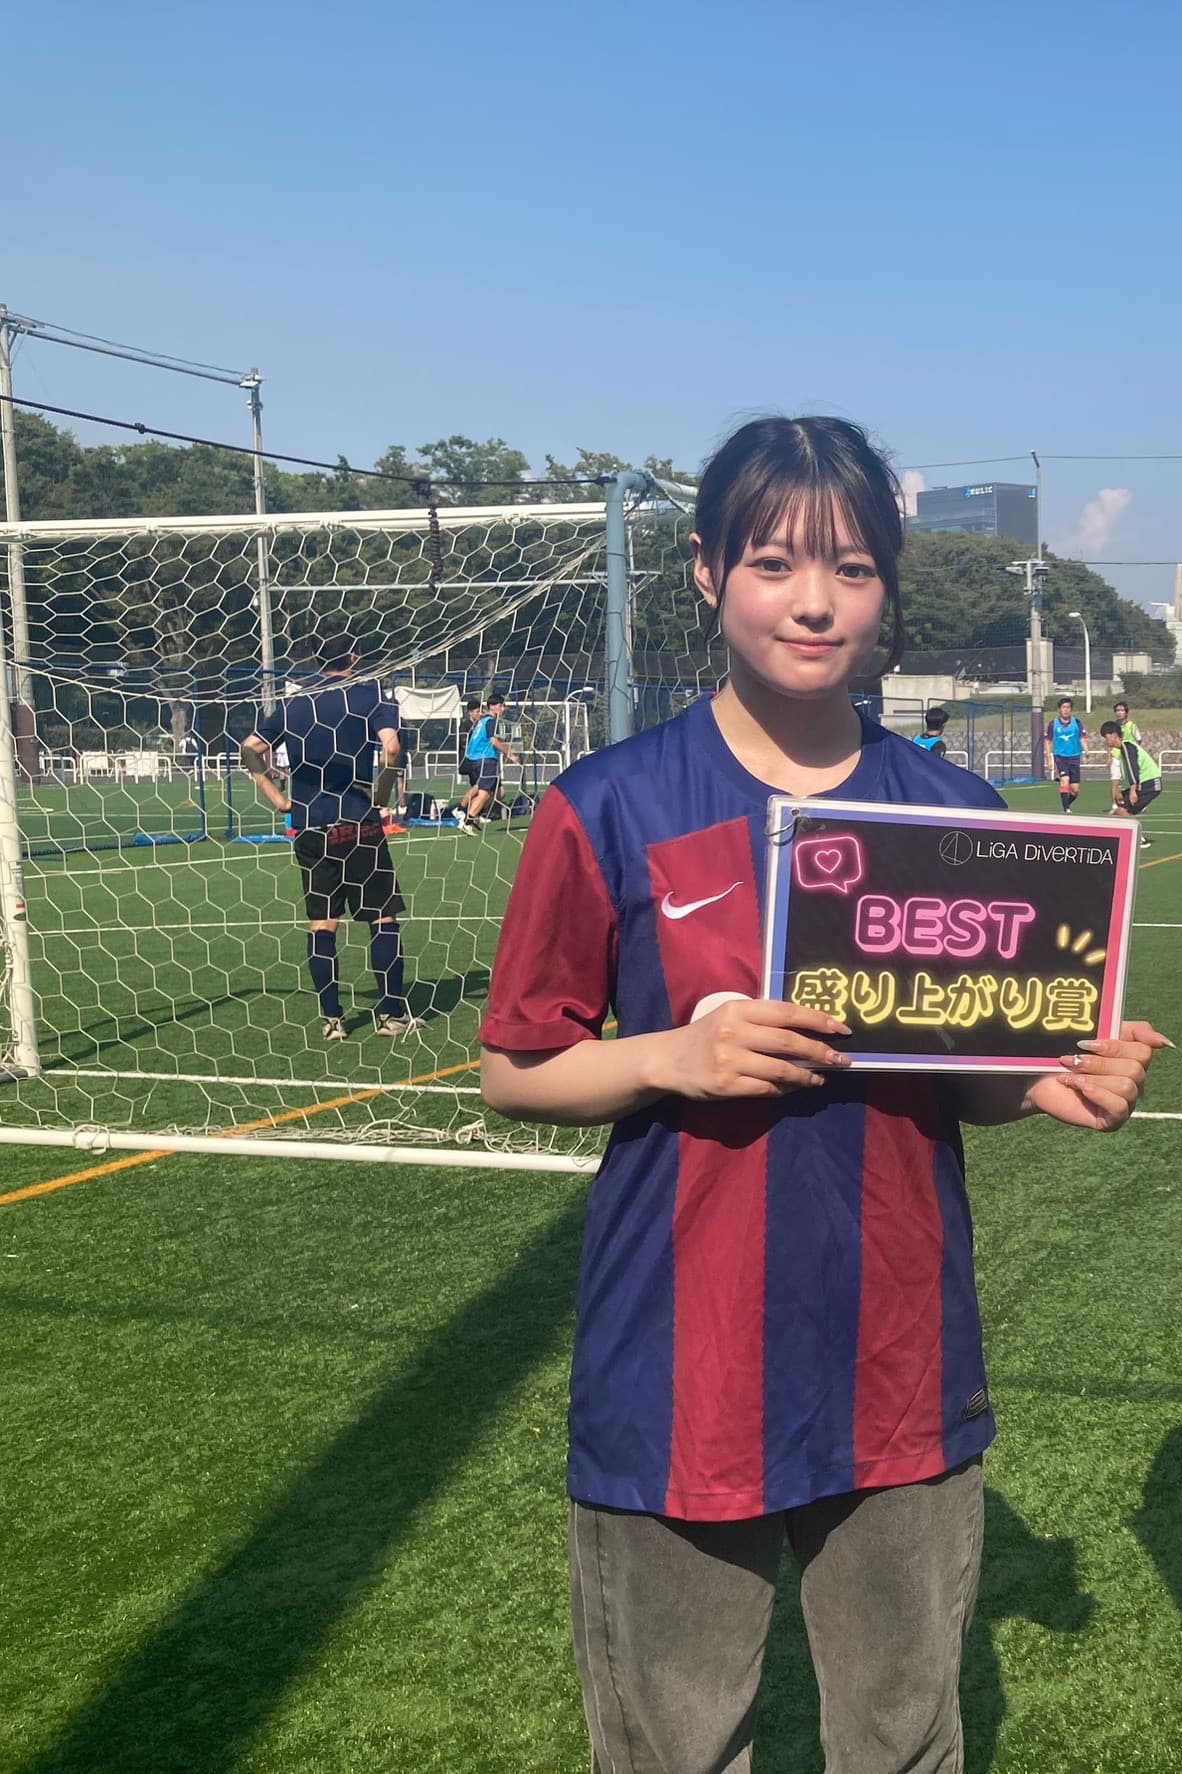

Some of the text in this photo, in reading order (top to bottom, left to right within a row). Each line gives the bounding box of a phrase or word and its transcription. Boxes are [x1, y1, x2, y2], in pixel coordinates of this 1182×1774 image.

[855, 894, 1036, 960] BEST
[791, 967, 1099, 1033] 盛り上がり賞
